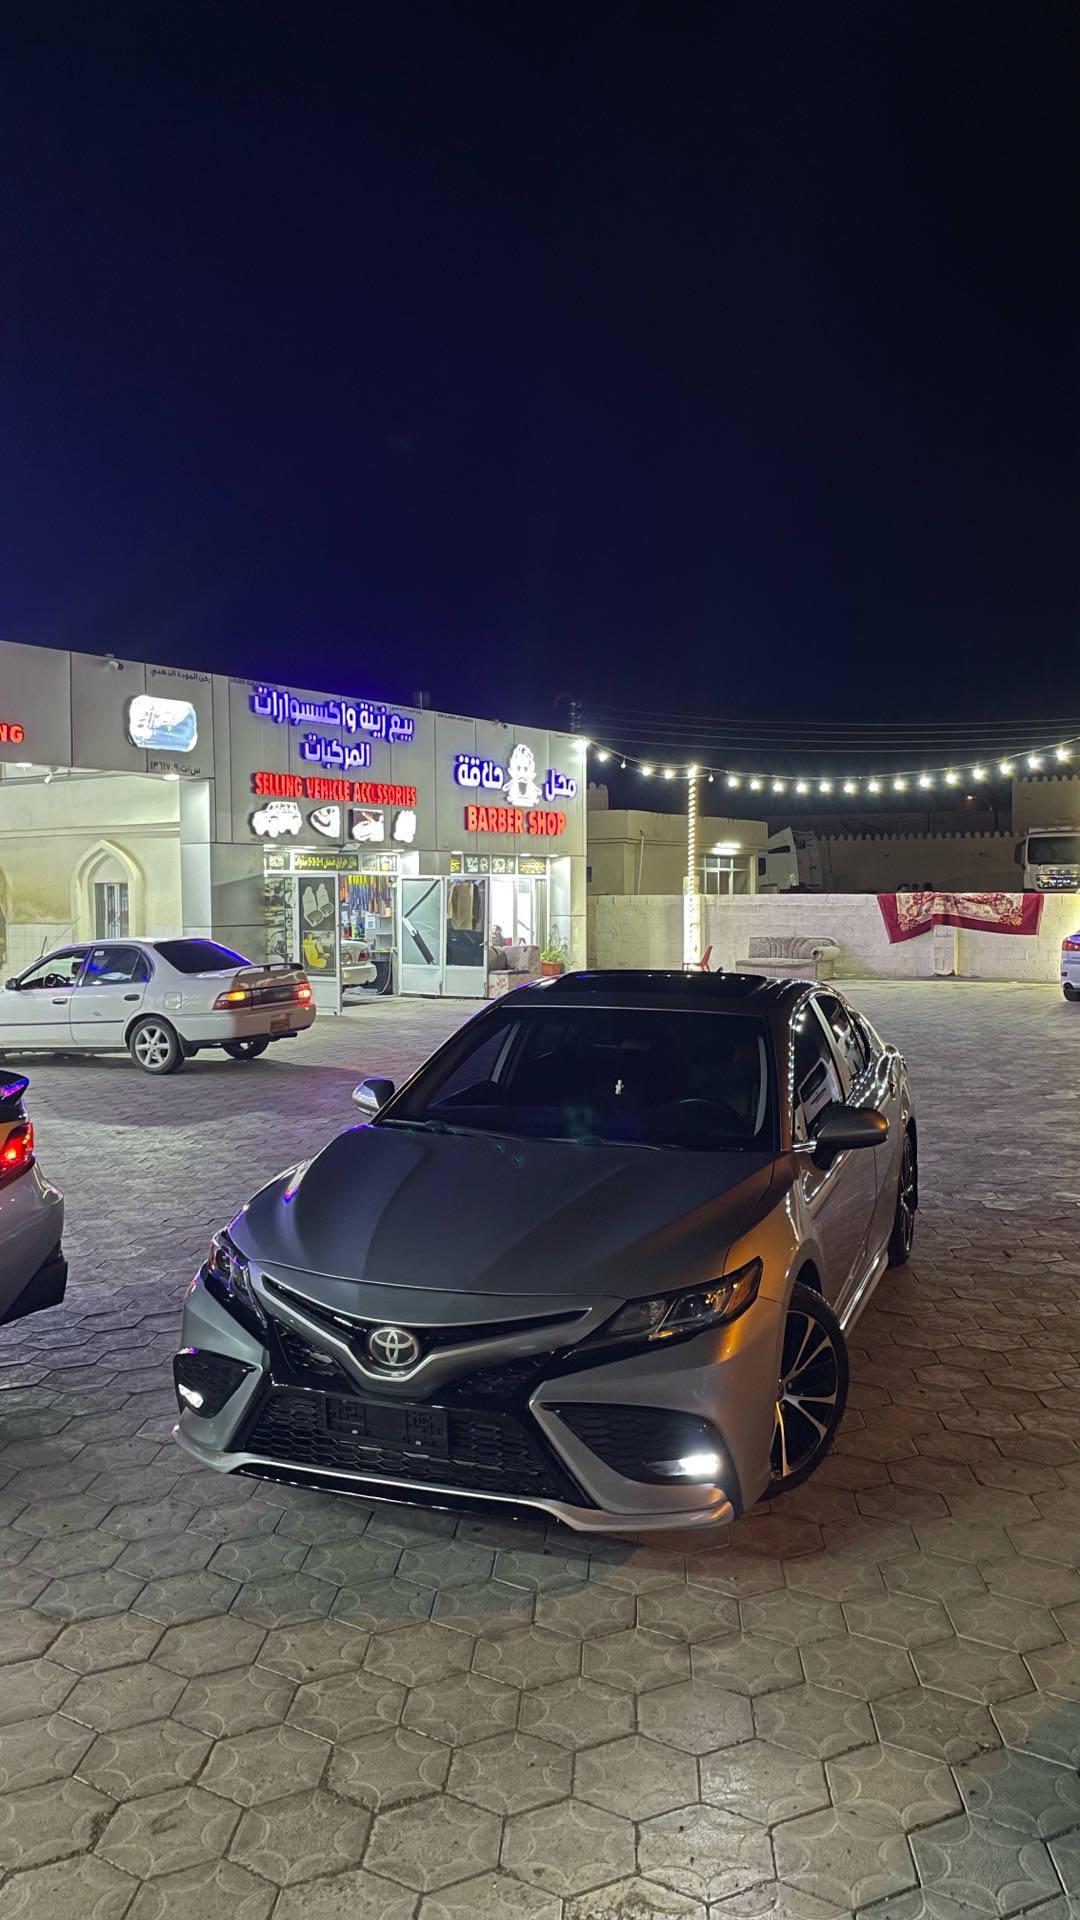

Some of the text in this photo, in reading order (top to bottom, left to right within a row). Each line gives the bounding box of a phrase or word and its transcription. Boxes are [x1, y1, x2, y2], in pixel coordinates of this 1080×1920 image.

[358, 701, 388, 739] زينة
[388, 713, 414, 744] بيع
[303, 732, 371, 771] المركبات
[254, 771, 416, 807] SELLING VEHICLE ACCESSORIES
[455, 754, 578, 802] محل حلاقة
[466, 804, 567, 837] BARBER SHOP
